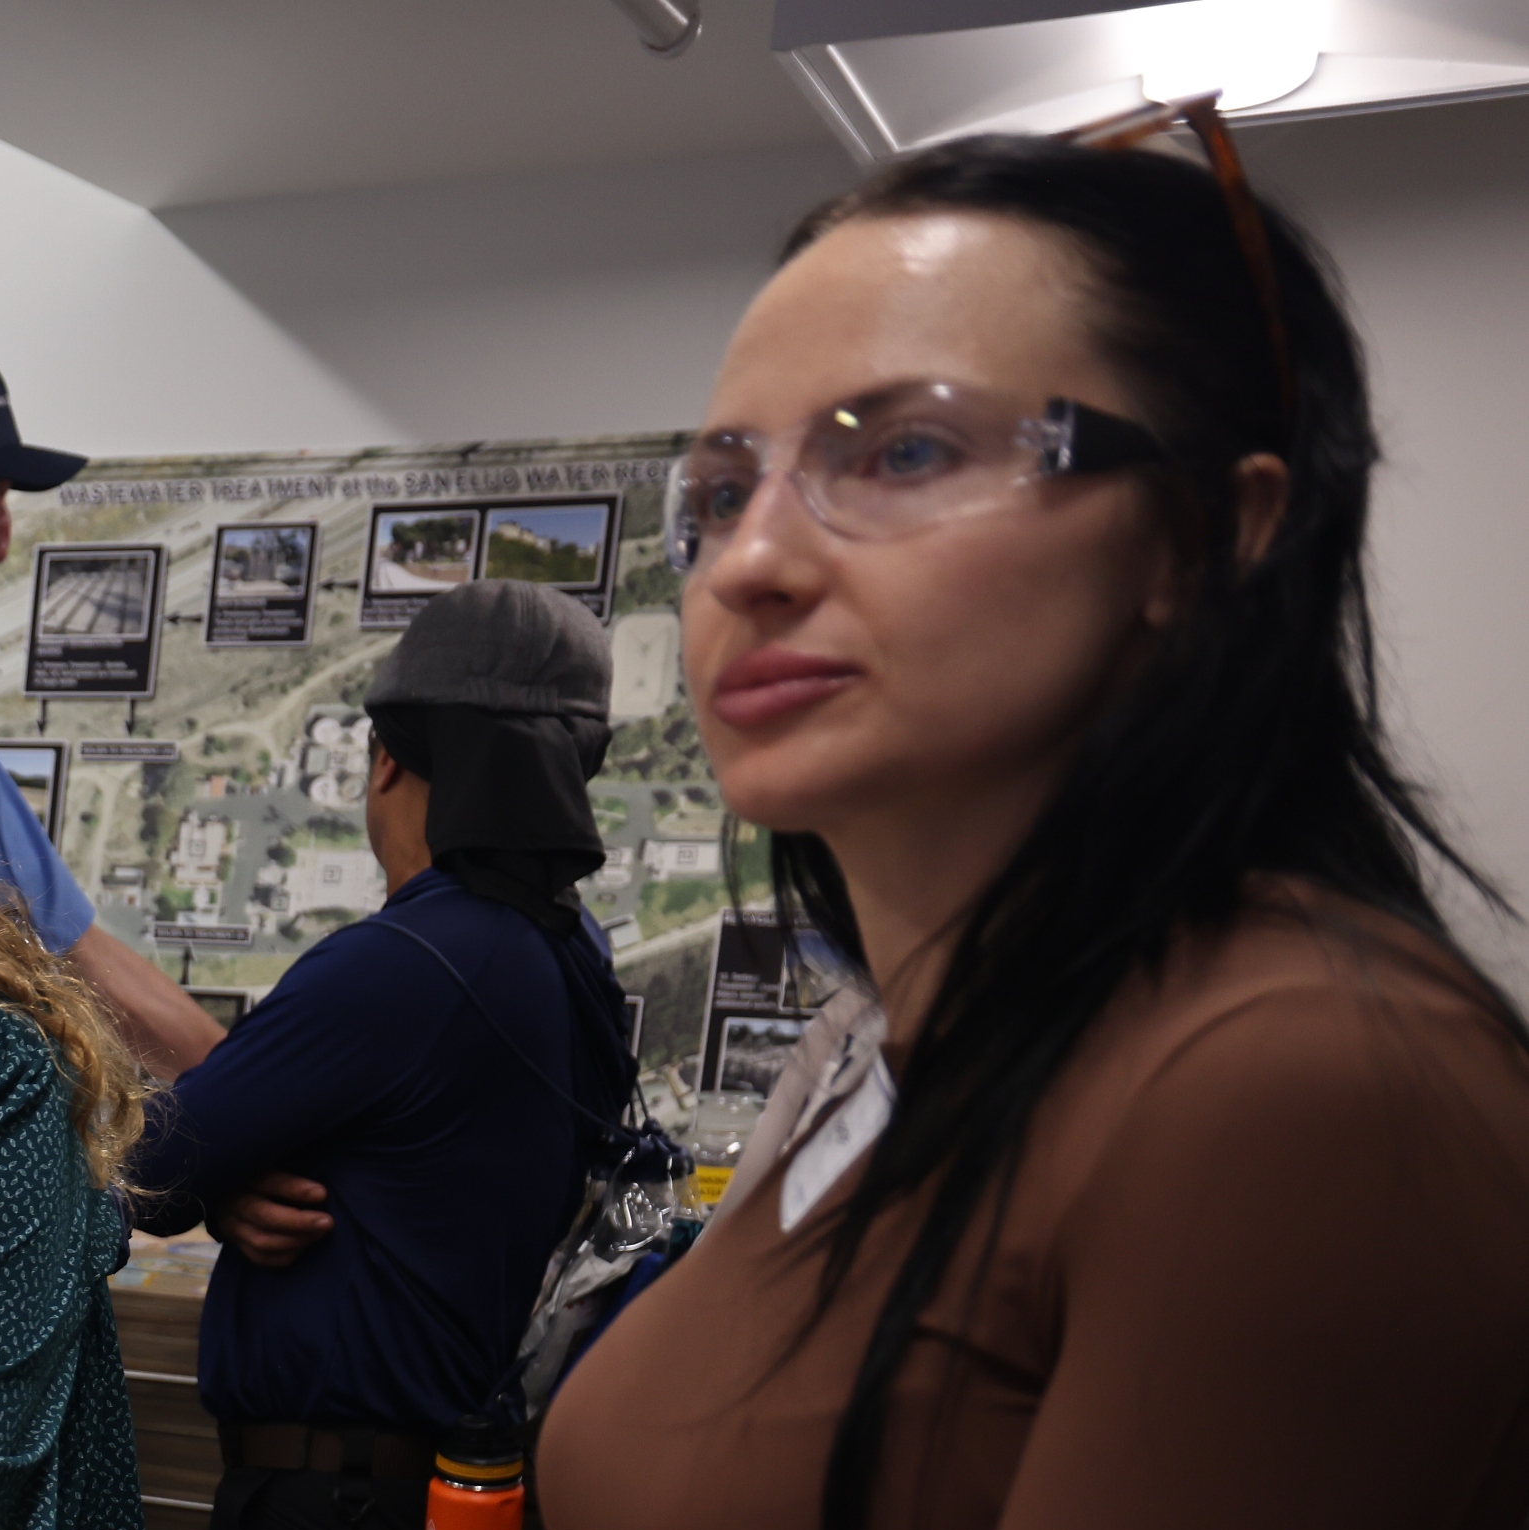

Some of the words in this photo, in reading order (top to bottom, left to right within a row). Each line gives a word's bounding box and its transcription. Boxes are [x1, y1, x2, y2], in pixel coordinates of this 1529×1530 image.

[59, 478, 205, 506] WASTEWATER
[208, 473, 338, 502] TREATMENT
[364, 474, 399, 497] the
[402, 470, 453, 497] SAN
[524, 463, 610, 491] WATER
